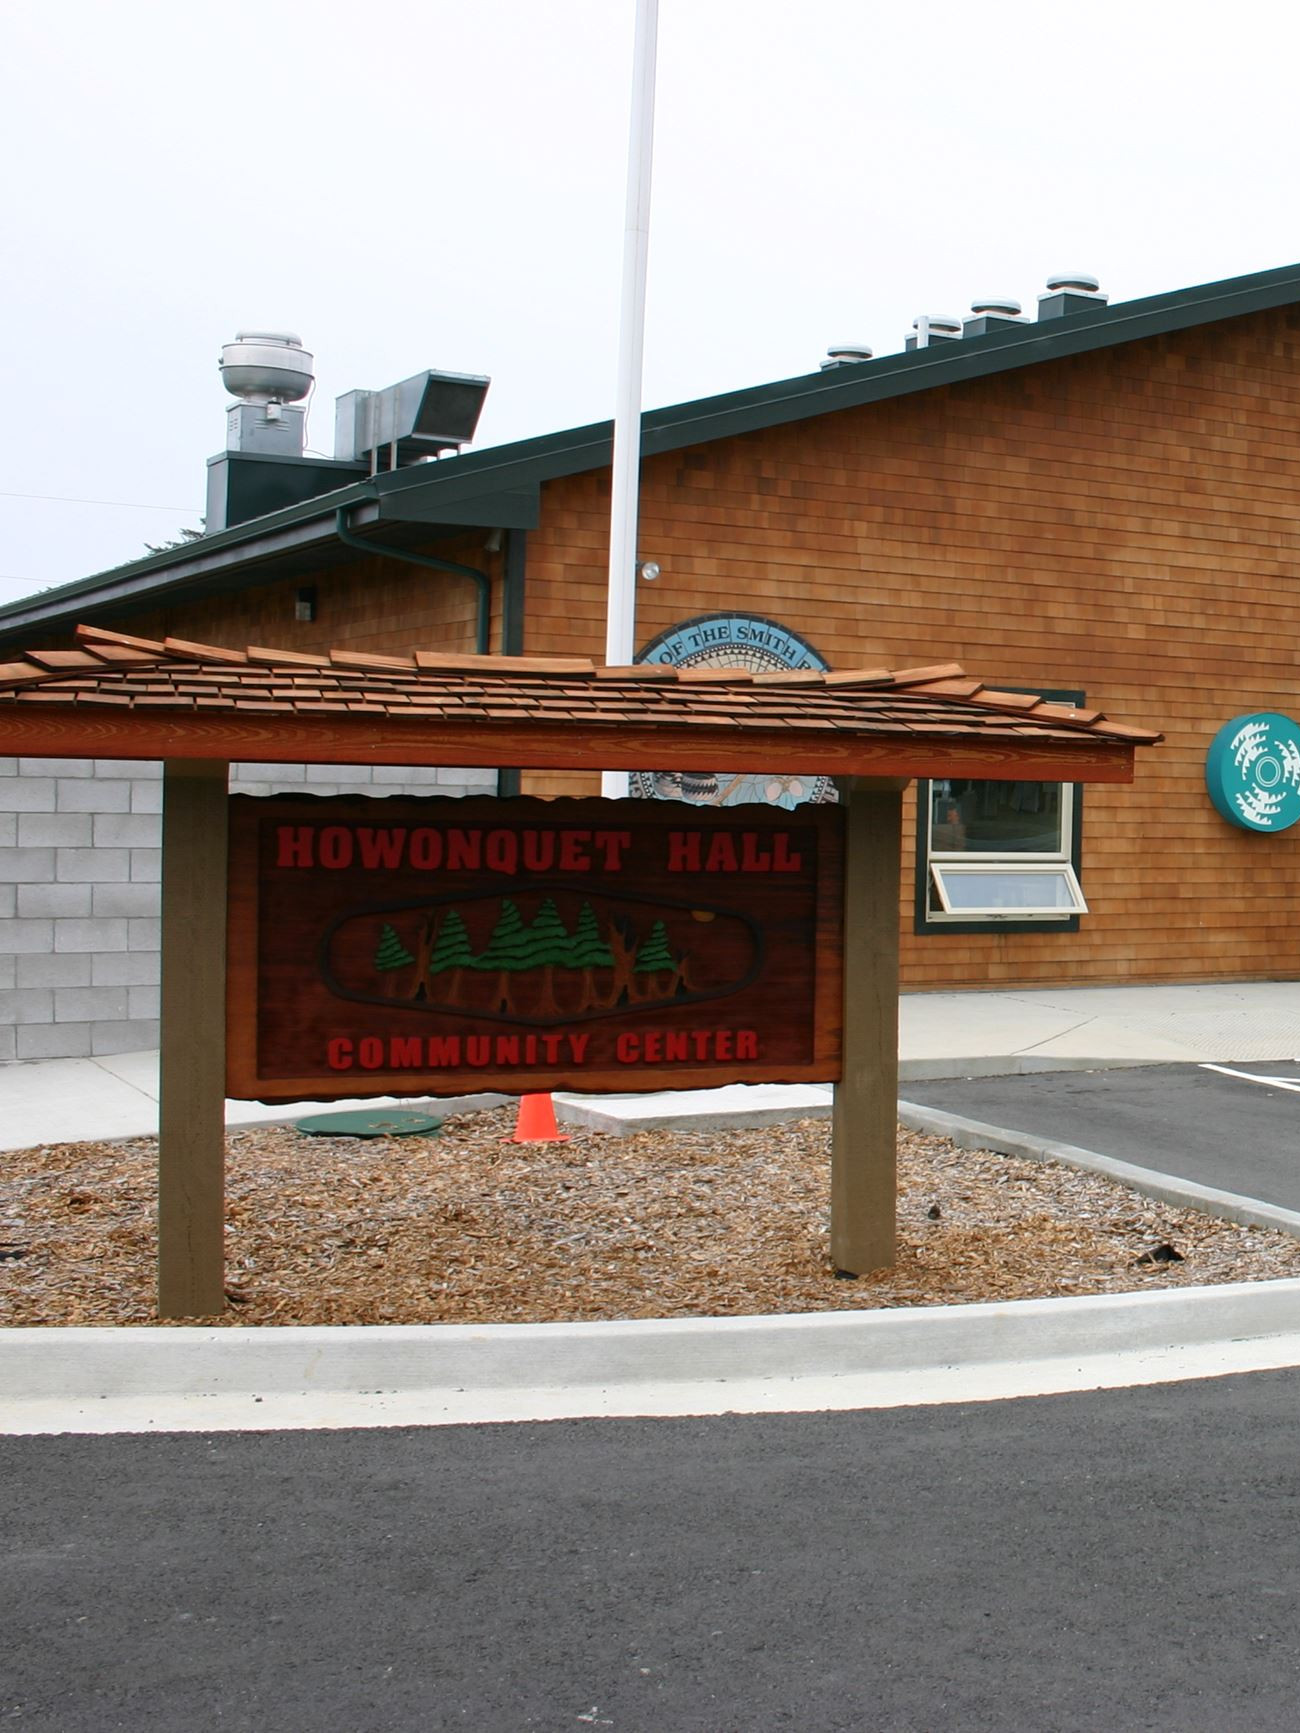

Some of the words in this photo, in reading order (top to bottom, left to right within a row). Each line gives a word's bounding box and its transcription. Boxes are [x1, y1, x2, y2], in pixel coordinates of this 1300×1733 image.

[659, 642, 684, 664] OF
[688, 627, 729, 647] THE
[737, 625, 796, 660] SMITH
[277, 826, 631, 874] HOWONQUET
[668, 833, 801, 872] HALL
[328, 1034, 592, 1070] COMMUNITY
[616, 1030, 758, 1064] CENTER
